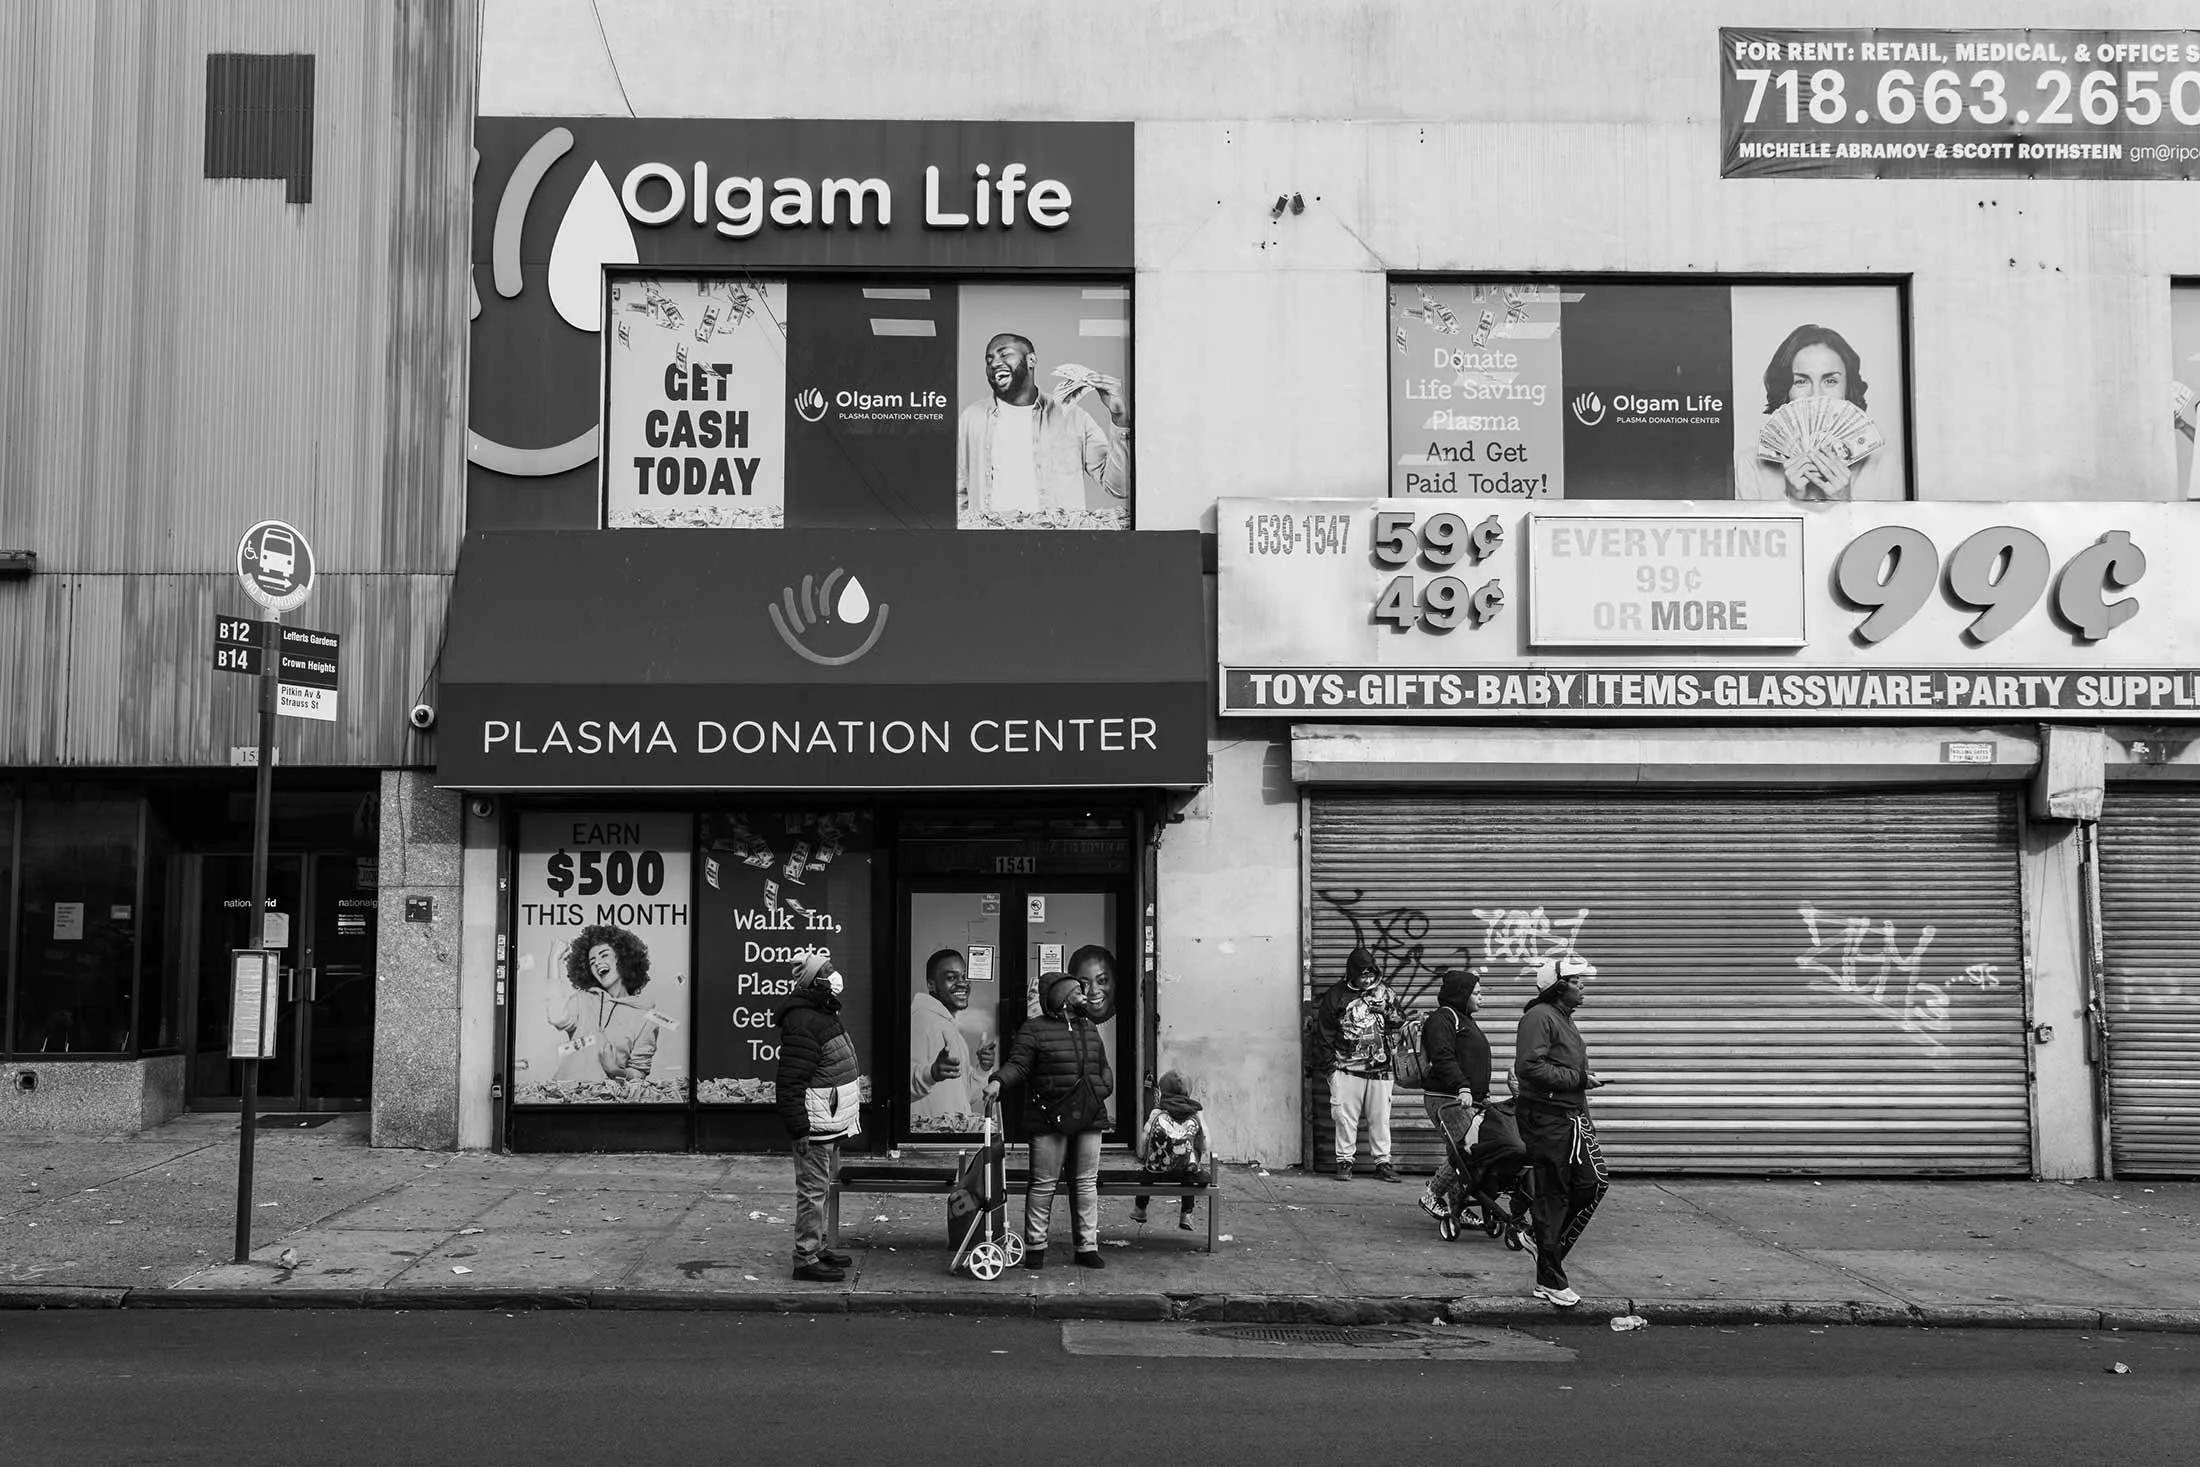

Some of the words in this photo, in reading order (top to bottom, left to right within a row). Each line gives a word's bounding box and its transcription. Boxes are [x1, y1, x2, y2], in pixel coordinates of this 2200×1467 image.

[1735, 42, 1782, 61] FOR
[1787, 42, 1855, 61] RENT:
[1861, 42, 1949, 64] RETAIL,
[1955, 43, 2068, 64] MEDICAL,
[2074, 43, 2091, 62] &
[2097, 43, 2181, 63] OFFICE
[1735, 69, 2200, 125] 718.663.2650
[1739, 143, 1831, 159] MICHELLE
[1836, 143, 1930, 159] ABRAMOV
[1934, 143, 1948, 159] &
[1952, 143, 2014, 159] SCOTT
[2019, 143, 2122, 160] ROTHSTEIN
[2130, 144, 2200, 162] gm@ripc
[621, 160, 892, 239] Olgam
[925, 162, 1073, 227] Life
[1434, 346, 1518, 370] Donate
[664, 362, 733, 401] GET
[1405, 378, 1452, 400] Life
[1463, 378, 1547, 406] Saving
[836, 390, 904, 410] Olgam
[911, 390, 947, 408] Life
[1613, 395, 1679, 414] Olgam
[1687, 394, 1723, 411] Life
[645, 410, 749, 449] CASH
[1432, 410, 1520, 431] Plasma
[1426, 440, 1475, 462] And
[1487, 442, 1527, 463] Get
[633, 456, 761, 496] TODAY
[1406, 471, 1456, 494] Paid
[1468, 472, 1548, 497] Today!
[1245, 514, 1350, 555] 1539-1547
[1373, 511, 1505, 565] 59¢
[1551, 528, 1787, 557] EVERYTHING
[245, 579, 259, 595] NO
[260, 584, 306, 606] STANDING
[1636, 565, 1703, 594] 99¢
[1836, 525, 2147, 645] 99¢
[1374, 576, 1505, 630] 49¢
[1594, 602, 1643, 631] OR
[1652, 601, 1748, 631] MORE
[219, 621, 250, 642] B12
[283, 630, 309, 643] Lefferts
[310, 634, 338, 647] Gardens
[218, 649, 248, 669] B14
[282, 657, 306, 669] Crown
[307, 660, 336, 673] Heights
[280, 697, 309, 708] Strauss
[311, 700, 319, 709] St
[281, 686, 302, 697] Pitkin
[304, 689, 314, 698] Av
[316, 690, 321, 699] &
[484, 720, 678, 754] PLASMA
[698, 720, 949, 754] DONATION
[970, 717, 1157, 753] CENTER
[572, 823, 640, 845] EARN
[546, 848, 665, 898] $500
[998, 857, 1035, 873] 1541
[521, 904, 584, 926] THIS
[597, 904, 688, 926] MONTH
[733, 907, 795, 930] Walk
[805, 909, 842, 933] In,
[732, 1006, 776, 1028] Get
